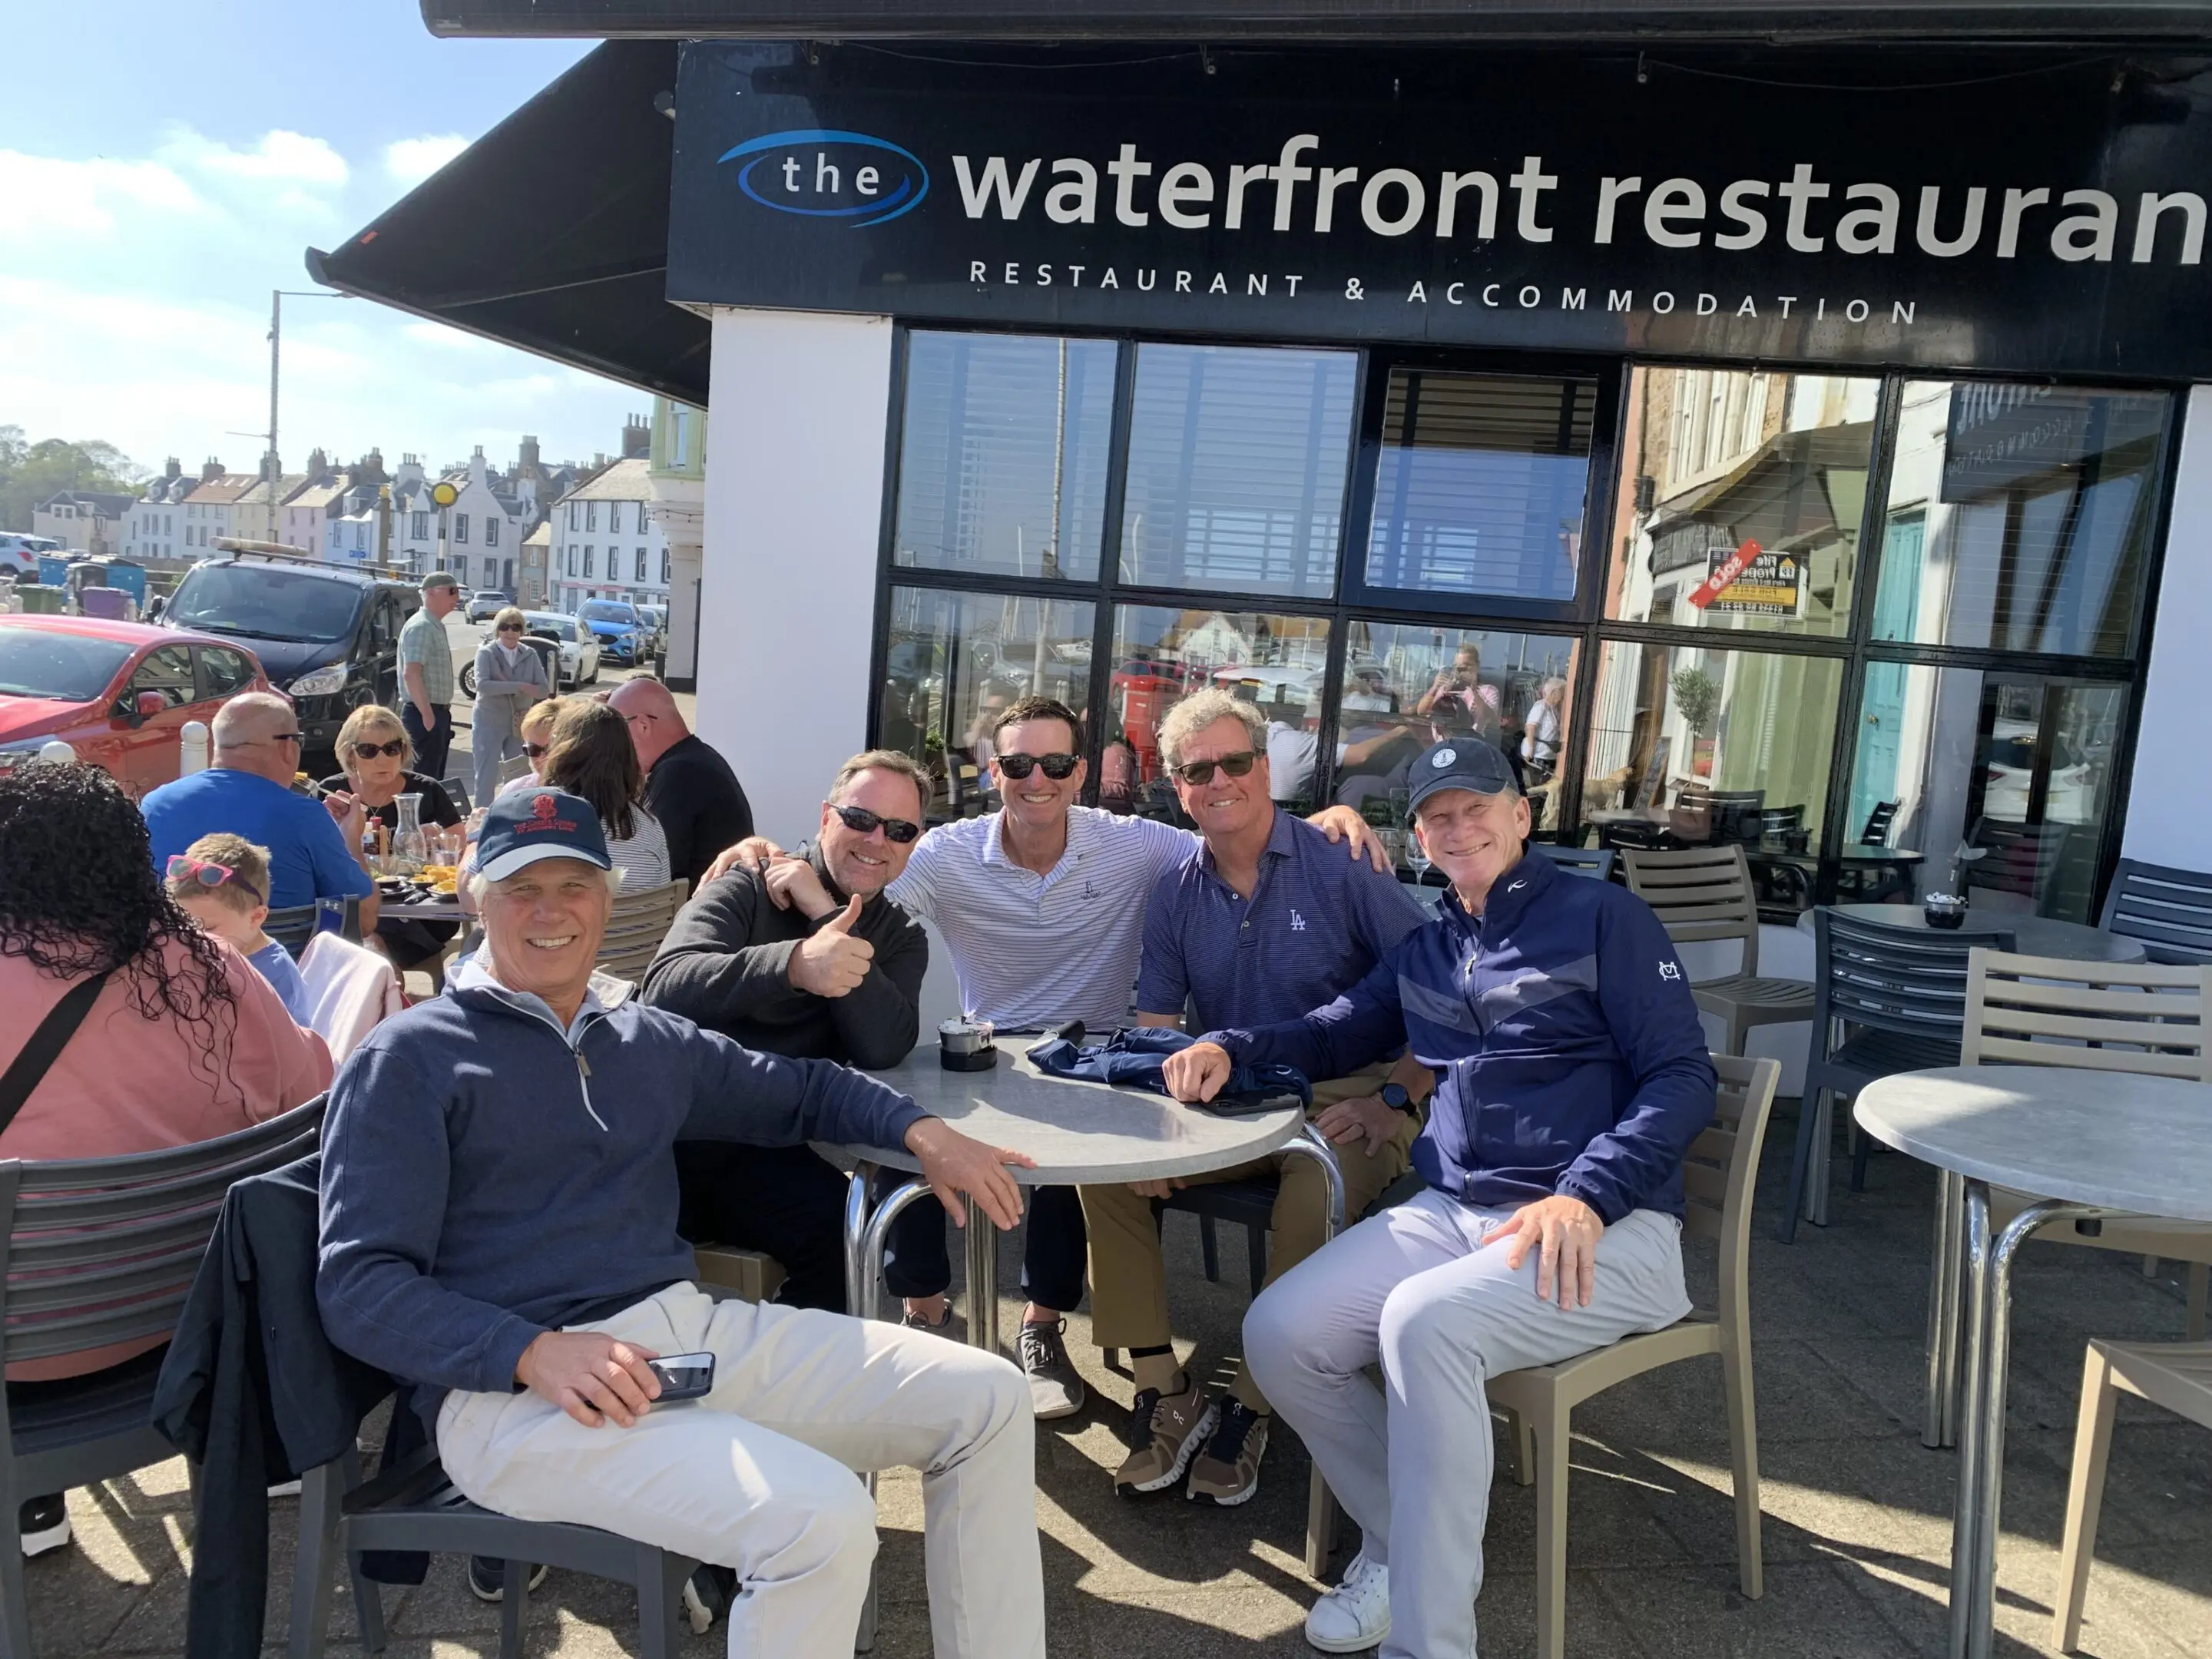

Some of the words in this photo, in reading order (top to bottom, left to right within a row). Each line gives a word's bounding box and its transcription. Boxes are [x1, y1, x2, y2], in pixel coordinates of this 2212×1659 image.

[782, 152, 880, 195] the
[952, 134, 1558, 243] waterfront
[1594, 164, 2208, 265] restauran
[970, 260, 1303, 298] RESTAURANT
[1345, 277, 1365, 300] &
[1406, 280, 1918, 325] ACCOMMODATION
[1290, 909, 1306, 931] LA
